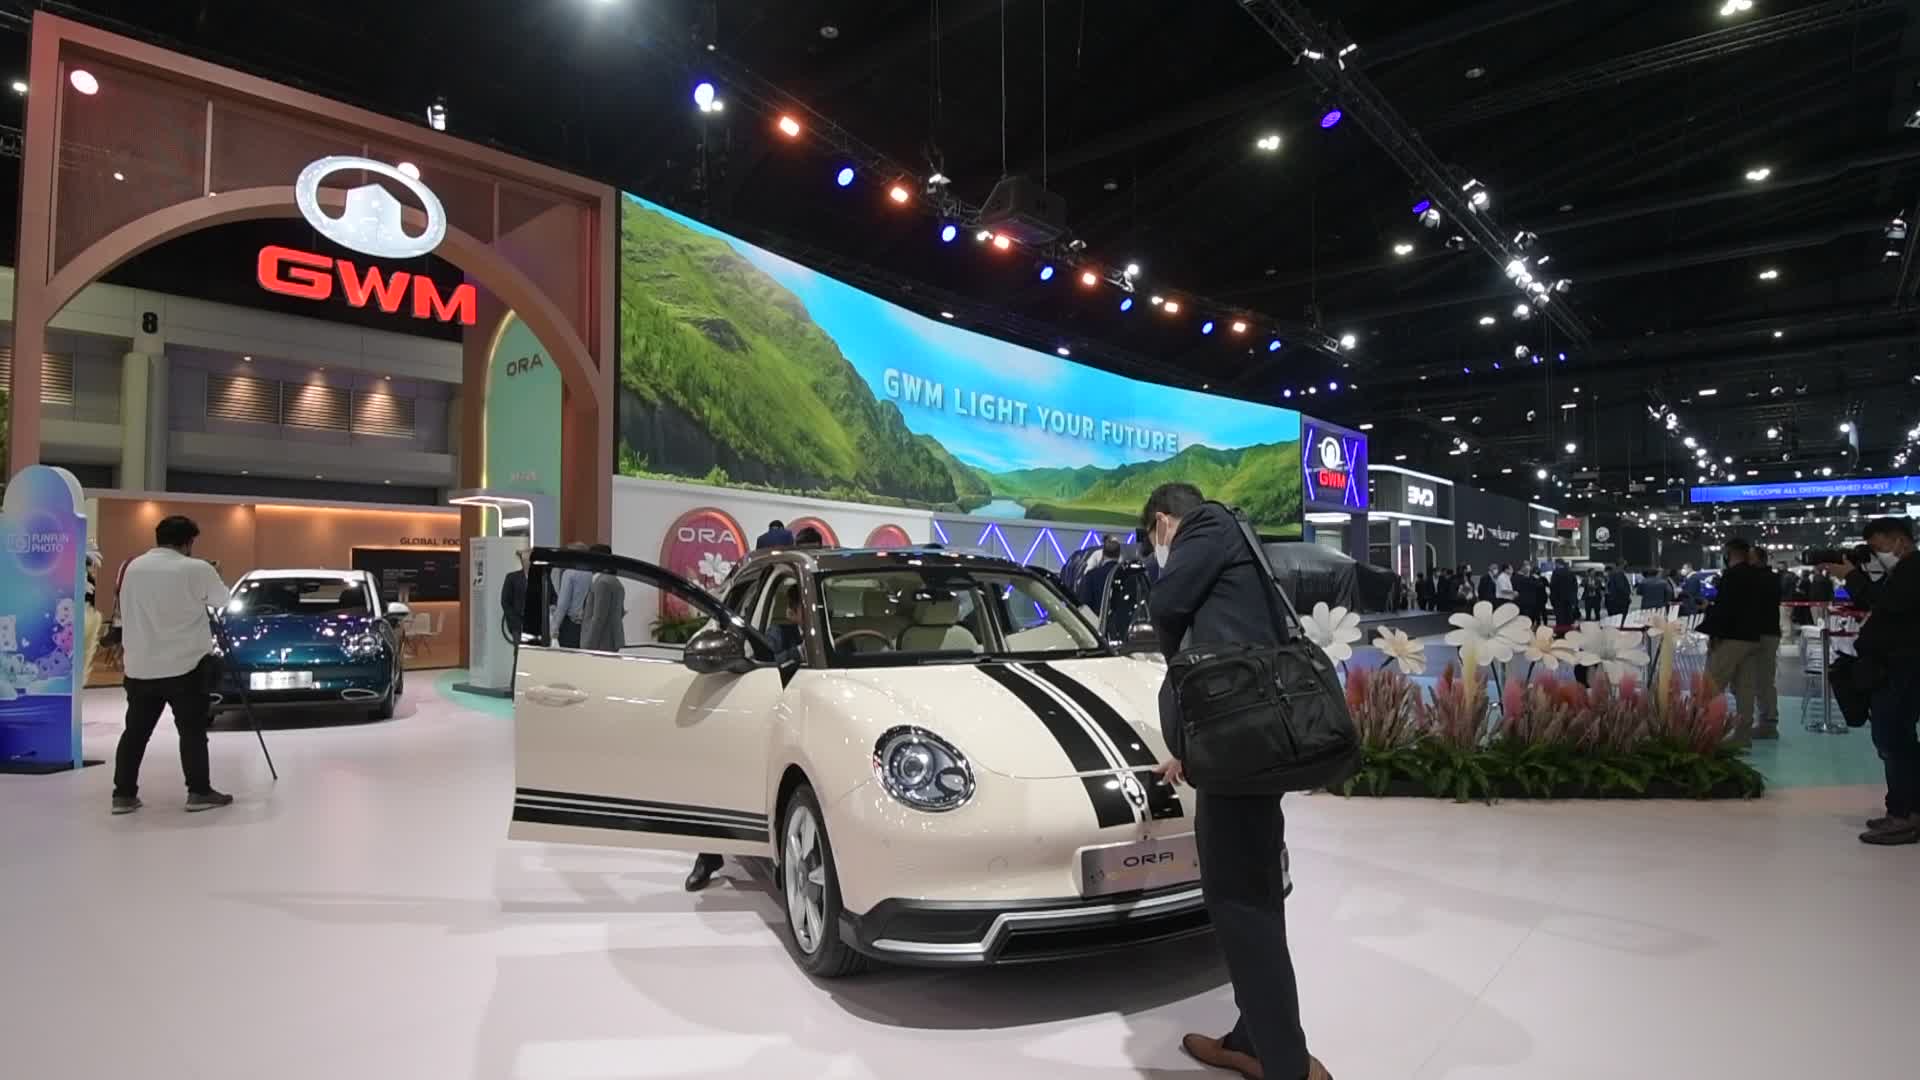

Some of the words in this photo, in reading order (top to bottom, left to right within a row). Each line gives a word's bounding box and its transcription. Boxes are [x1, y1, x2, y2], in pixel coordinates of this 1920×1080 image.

[257, 245, 477, 326] GWM
[142, 311, 159, 334] 8
[506, 353, 544, 377] ORA
[883, 368, 944, 409] GWM
[954, 387, 1029, 426] LIGHT
[1037, 406, 1096, 441] YOUR
[1100, 419, 1179, 453] FUTURE
[1318, 469, 1346, 488] GWM
[1407, 485, 1434, 507] BYD
[1742, 488, 1781, 497] WELCOME
[1783, 487, 1798, 495] ALL
[678, 527, 736, 543] ORA
[1466, 521, 1485, 540] BYD
[31, 543, 65, 553] PHOTO
[400, 536, 438, 546] GLOBAL
[1123, 851, 1175, 868] ORA
